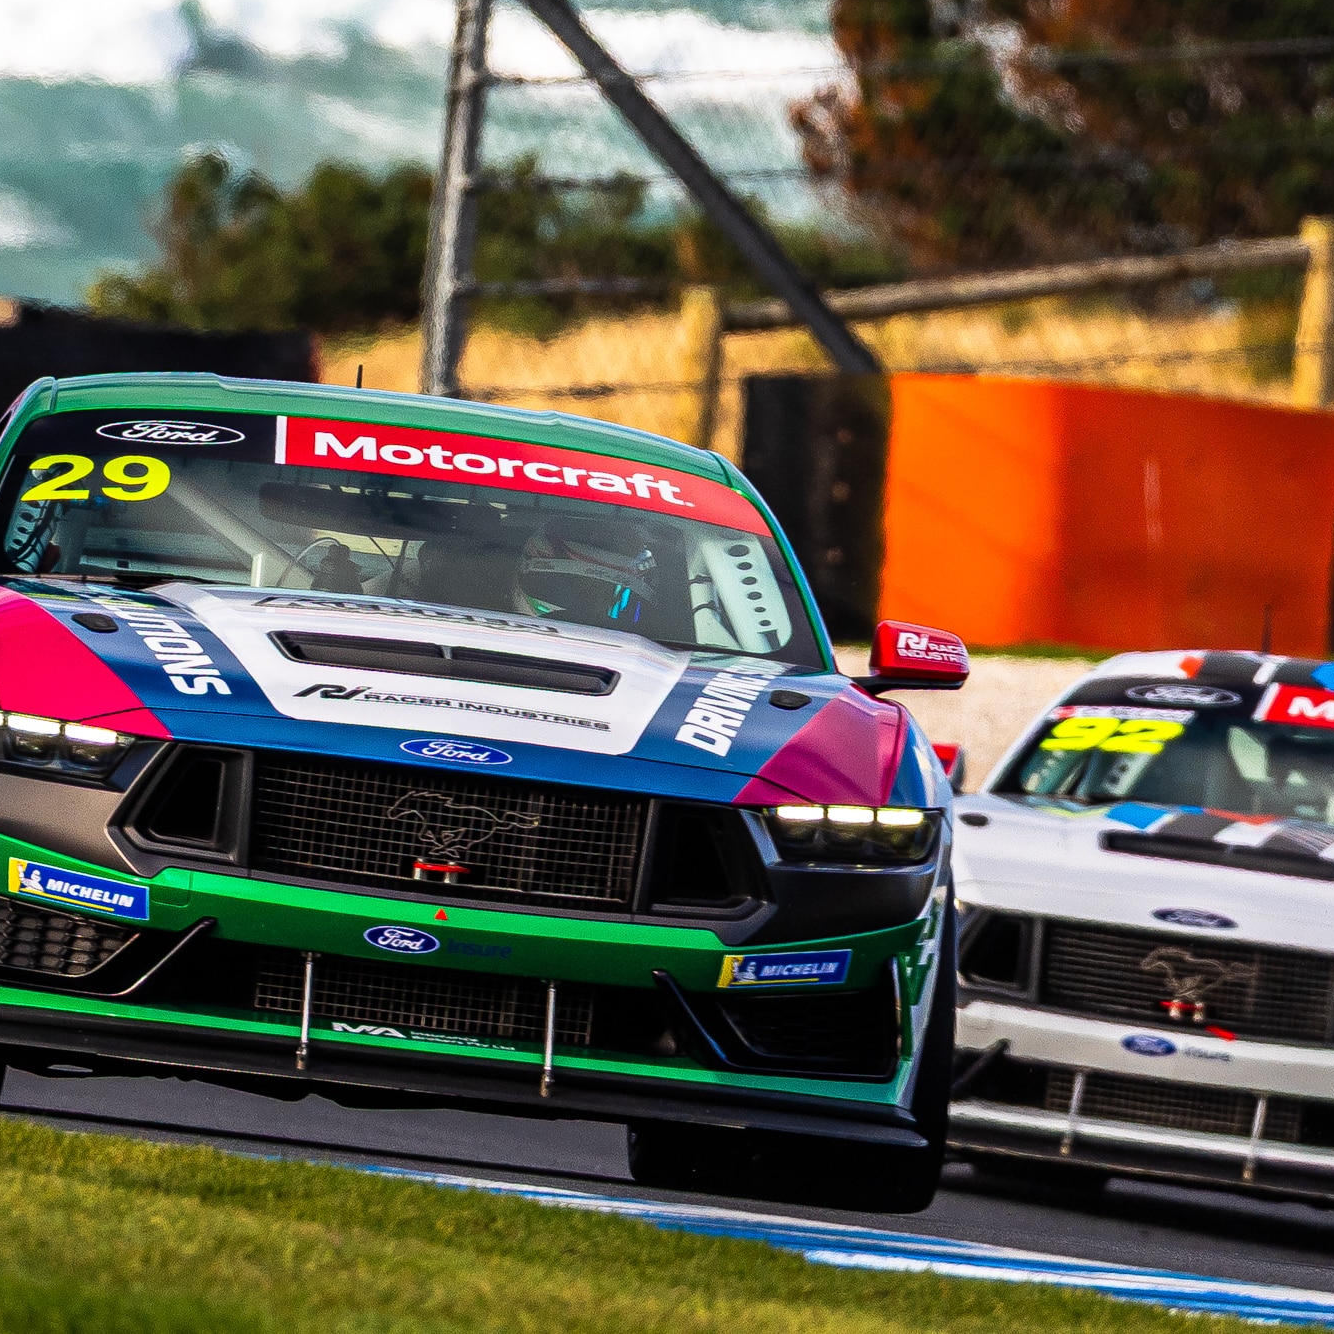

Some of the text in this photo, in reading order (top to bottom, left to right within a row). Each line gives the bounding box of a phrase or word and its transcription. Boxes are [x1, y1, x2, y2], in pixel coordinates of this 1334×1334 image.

[121, 421, 219, 443] Ford
[20, 455, 172, 502] 29
[363, 693, 453, 707] RACER
[458, 702, 611, 730] INDUSTRIES
[421, 740, 492, 762] Ford
[46, 878, 135, 908] MICHELIN
[376, 927, 427, 951] Ford
[759, 961, 840, 977] MICHELIN
